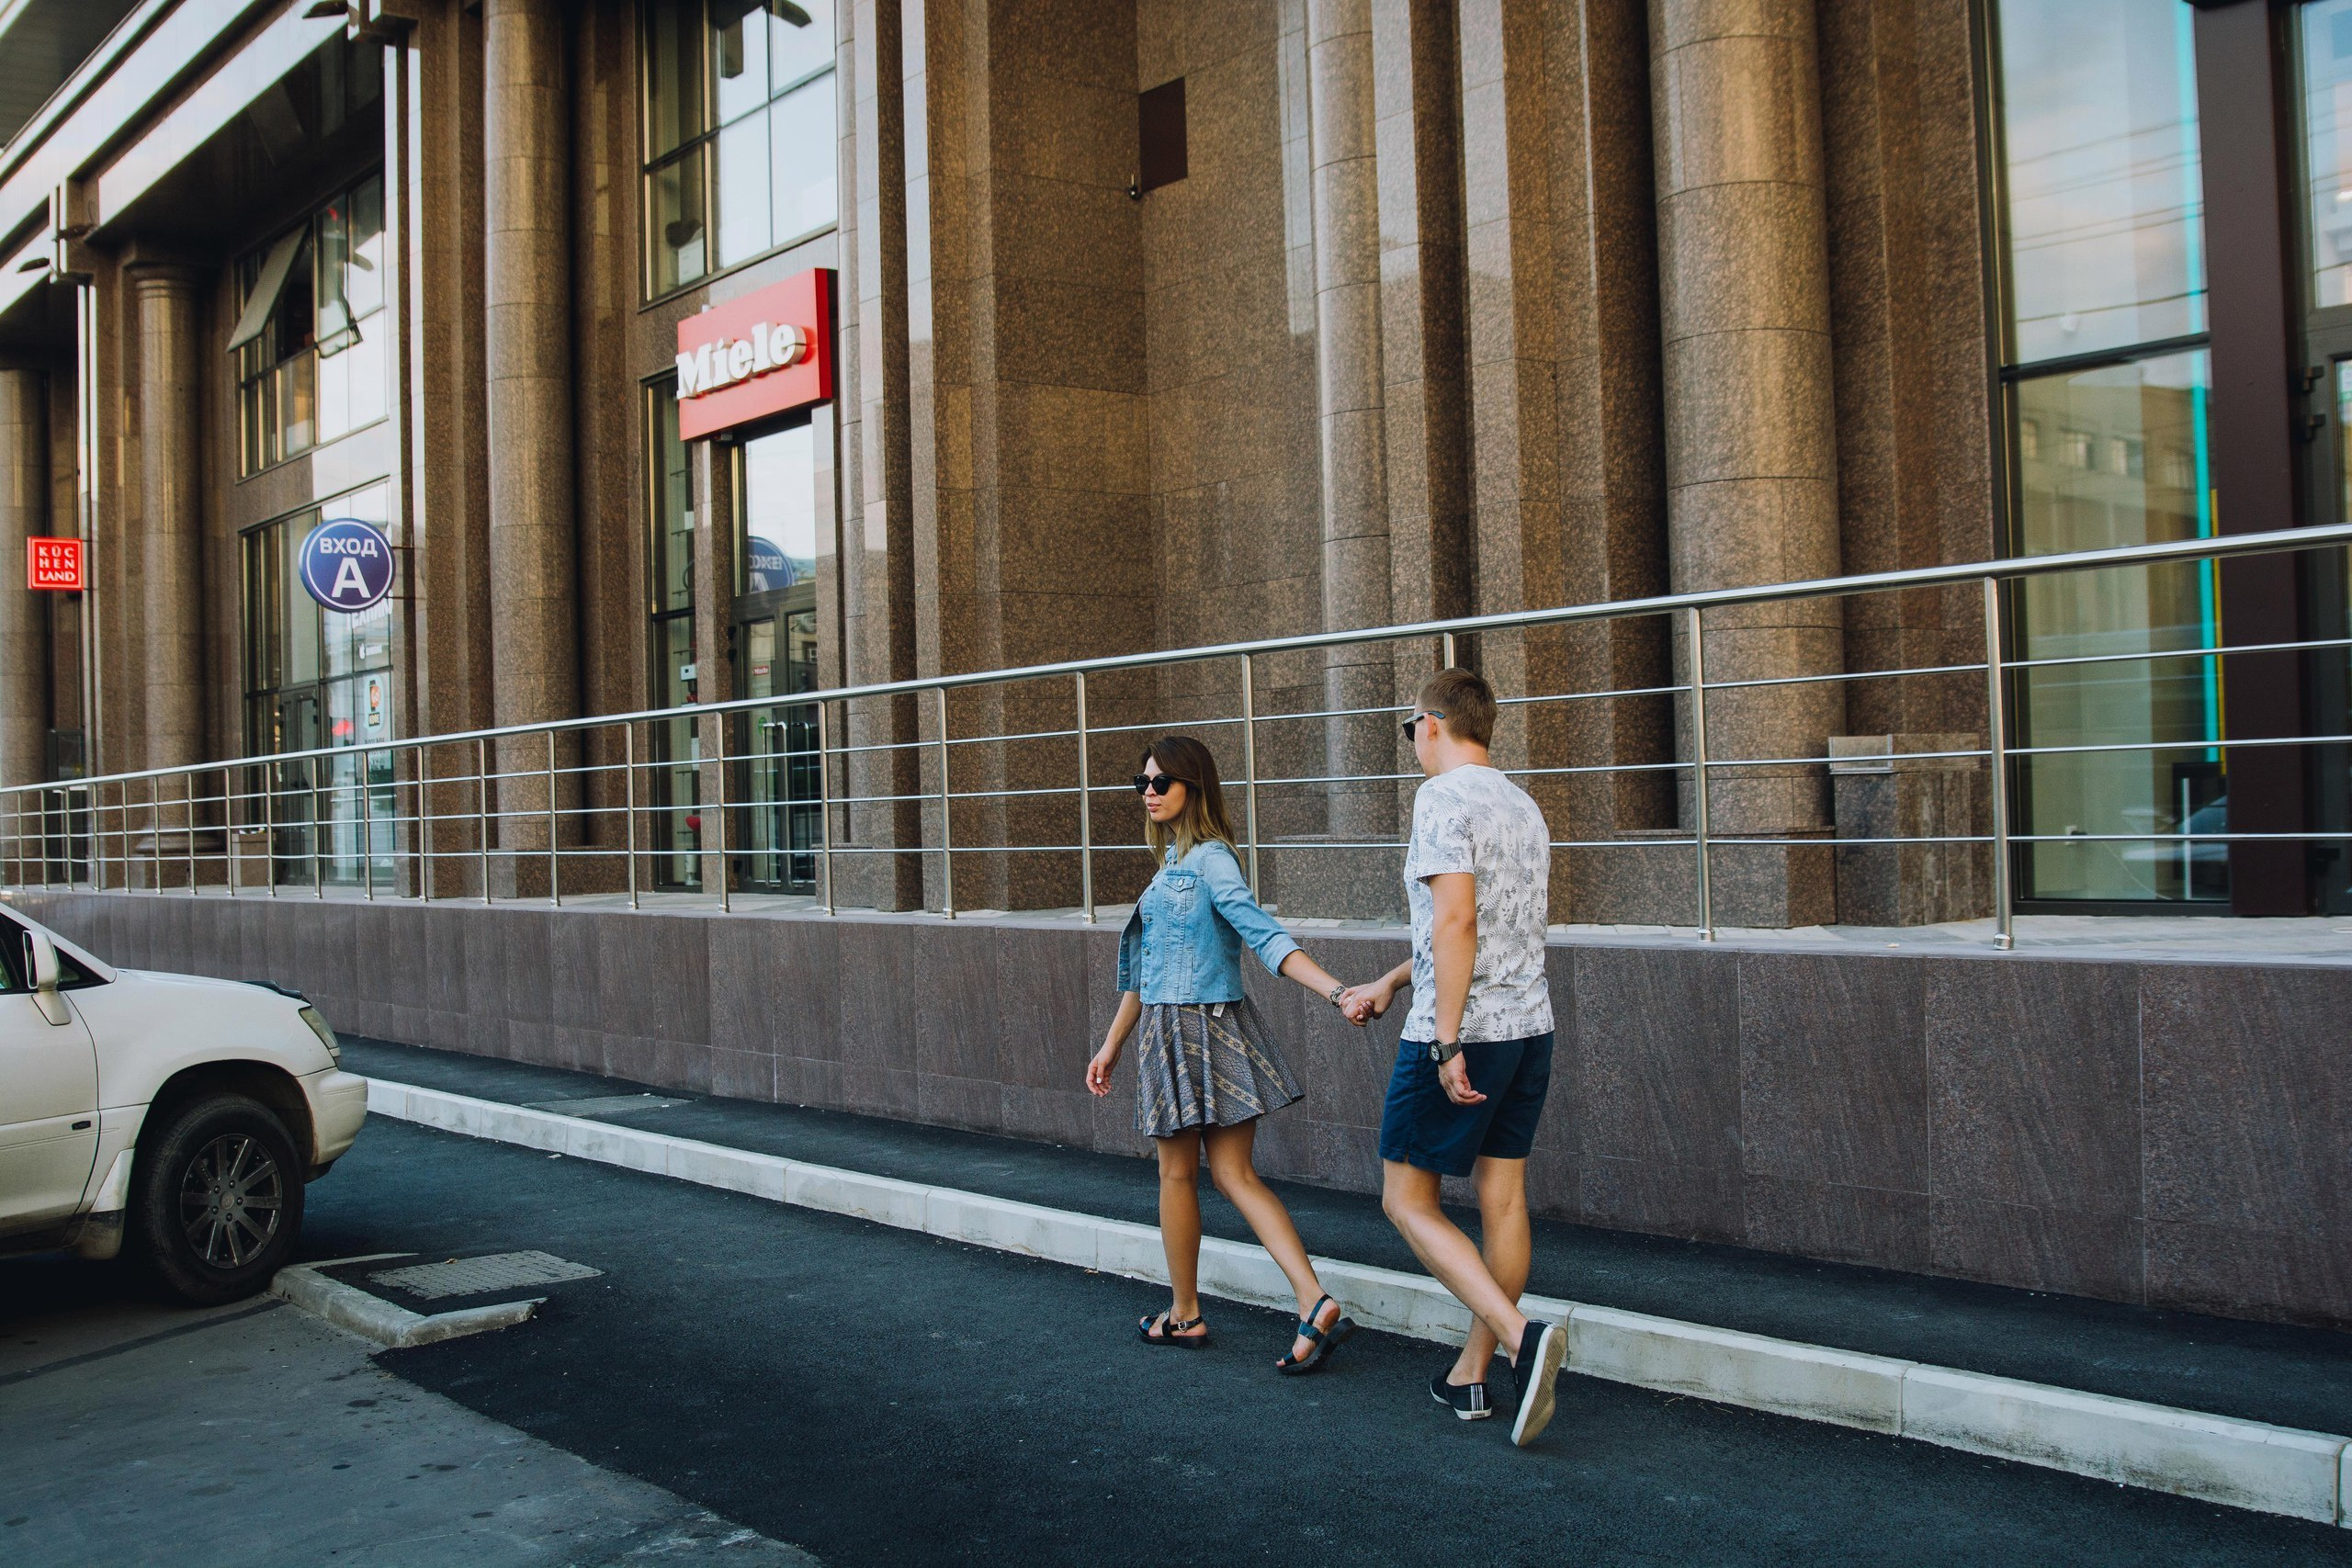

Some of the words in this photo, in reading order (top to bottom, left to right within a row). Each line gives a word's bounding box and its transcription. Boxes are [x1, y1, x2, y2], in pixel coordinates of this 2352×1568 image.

[675, 321, 806, 400] Miele
[39, 545, 74, 558] KÜC
[319, 537, 379, 558] ВХОД
[39, 558, 75, 569] HEN
[39, 570, 76, 581] LAND
